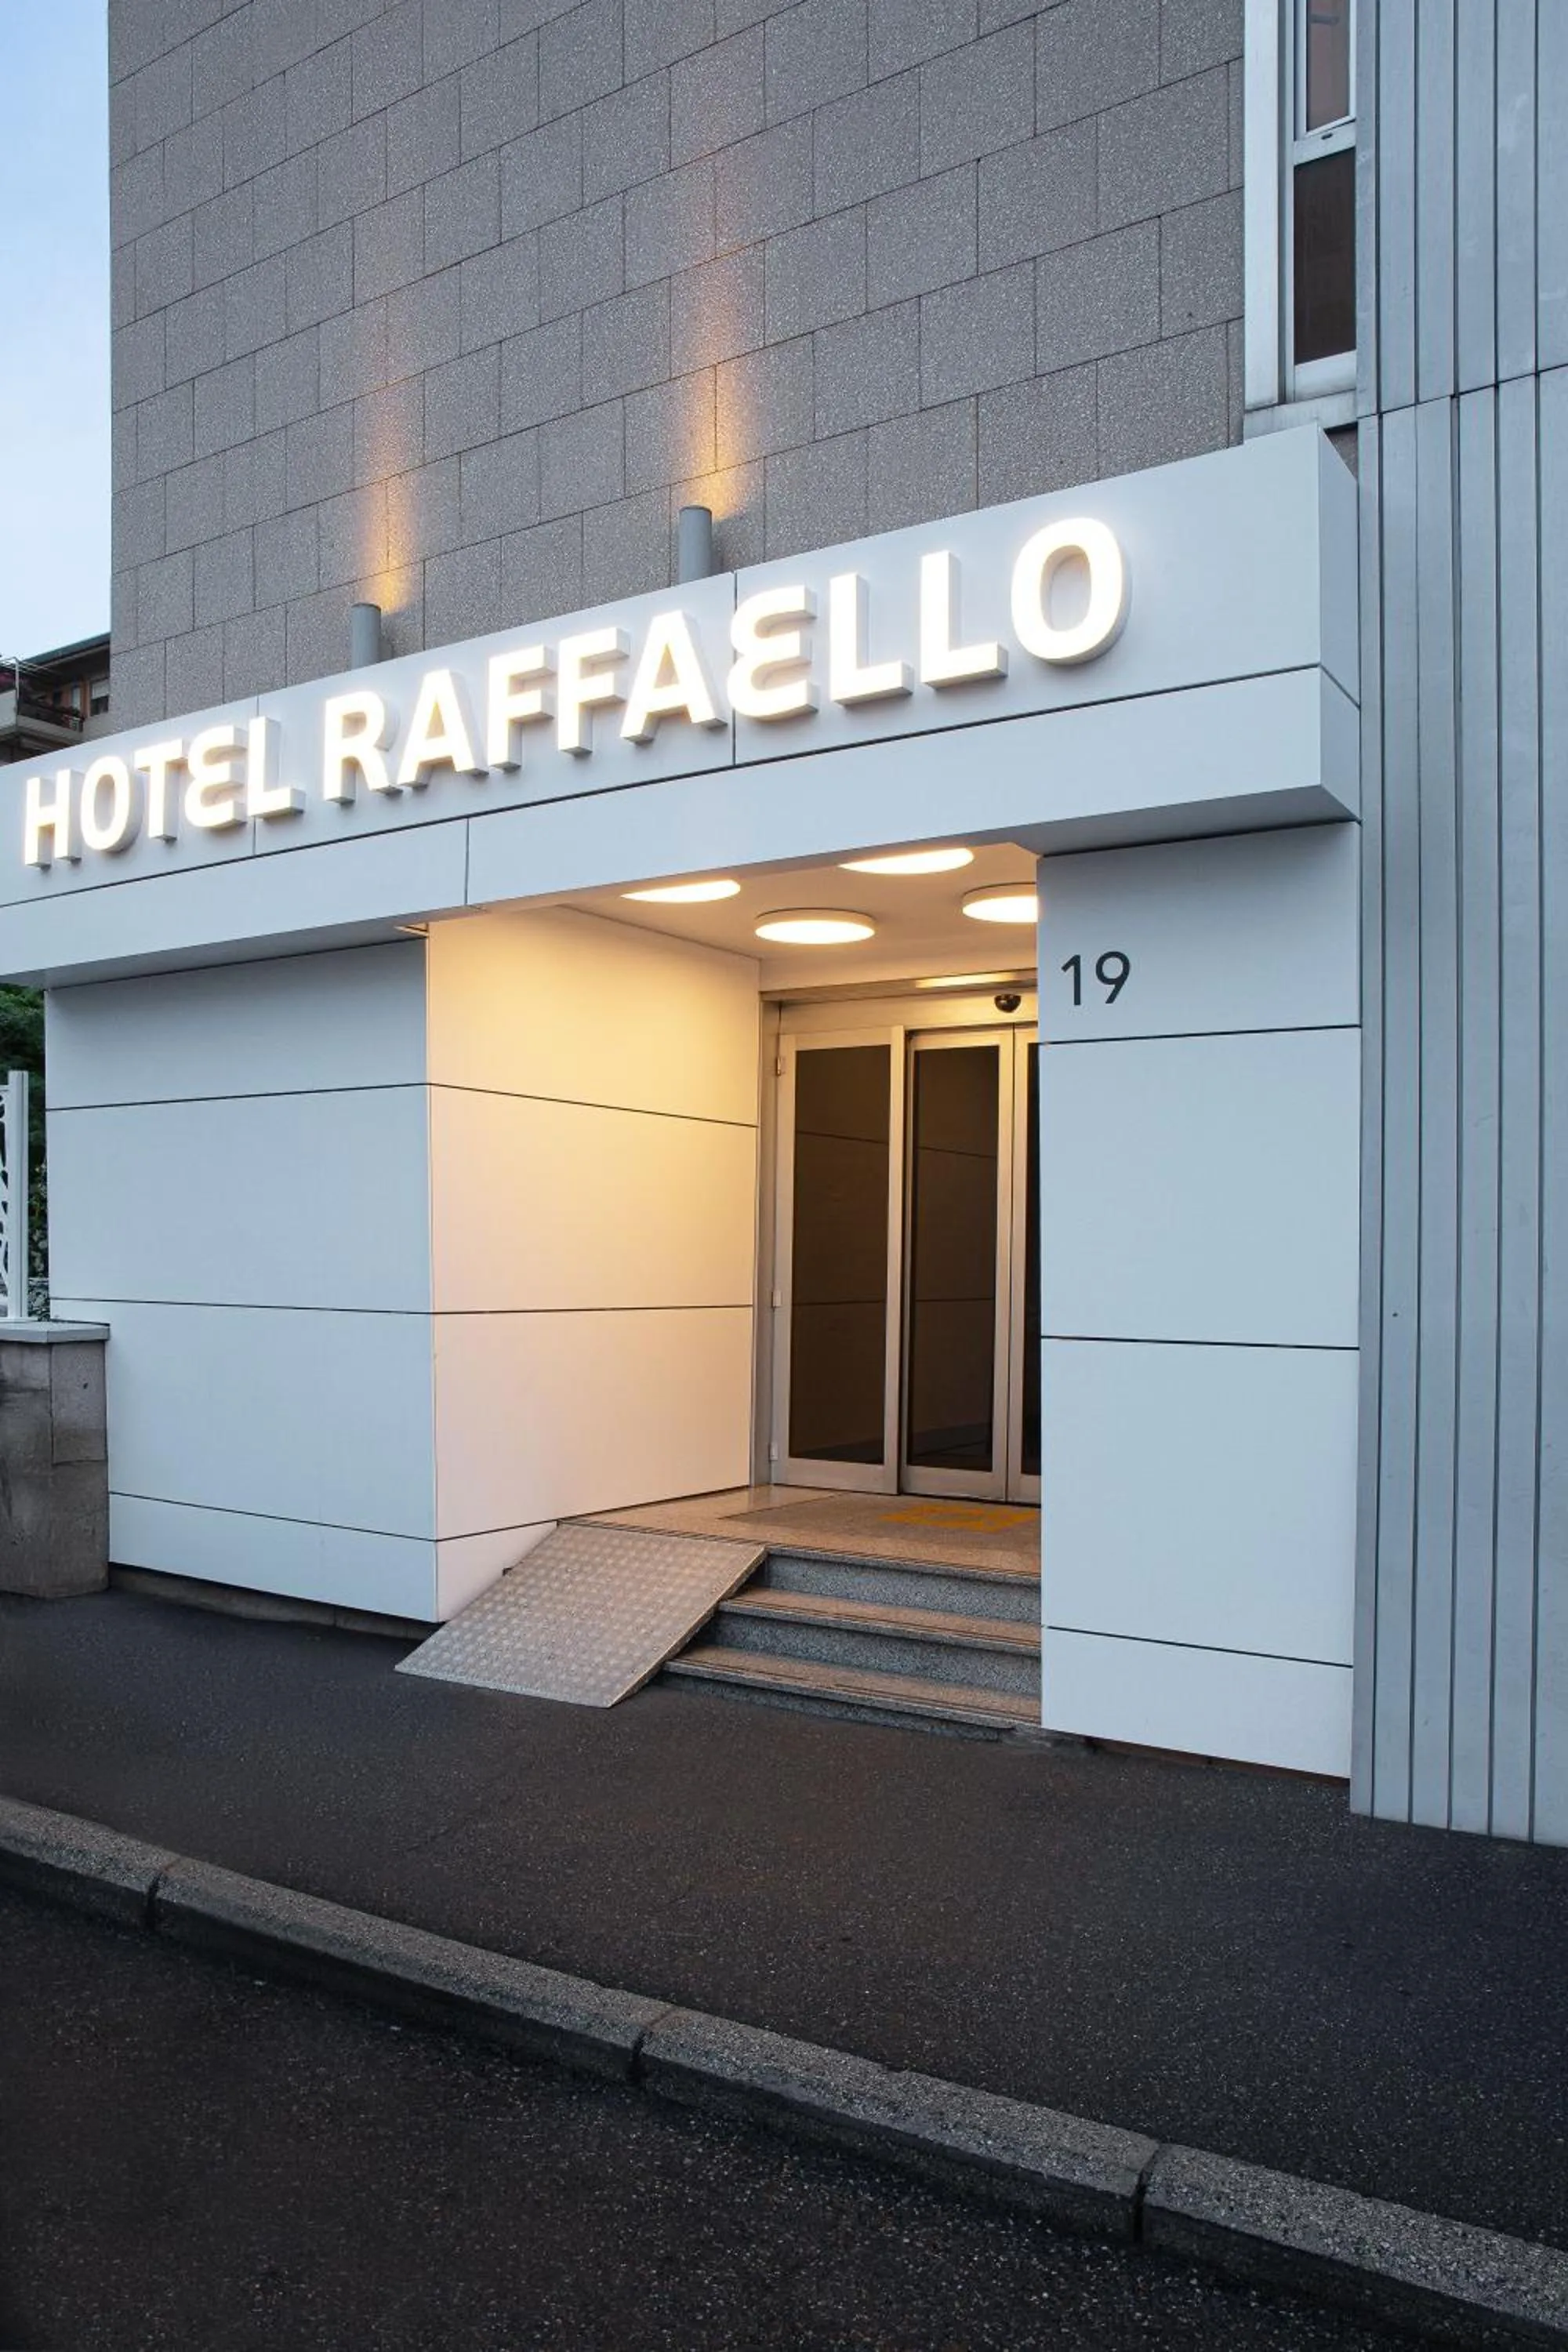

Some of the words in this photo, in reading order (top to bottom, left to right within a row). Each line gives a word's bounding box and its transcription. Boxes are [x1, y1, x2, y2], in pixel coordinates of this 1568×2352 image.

[23, 714, 306, 868] HOTEL
[322, 515, 1131, 806] RAFFAELLO
[1061, 950, 1131, 1007] 19
